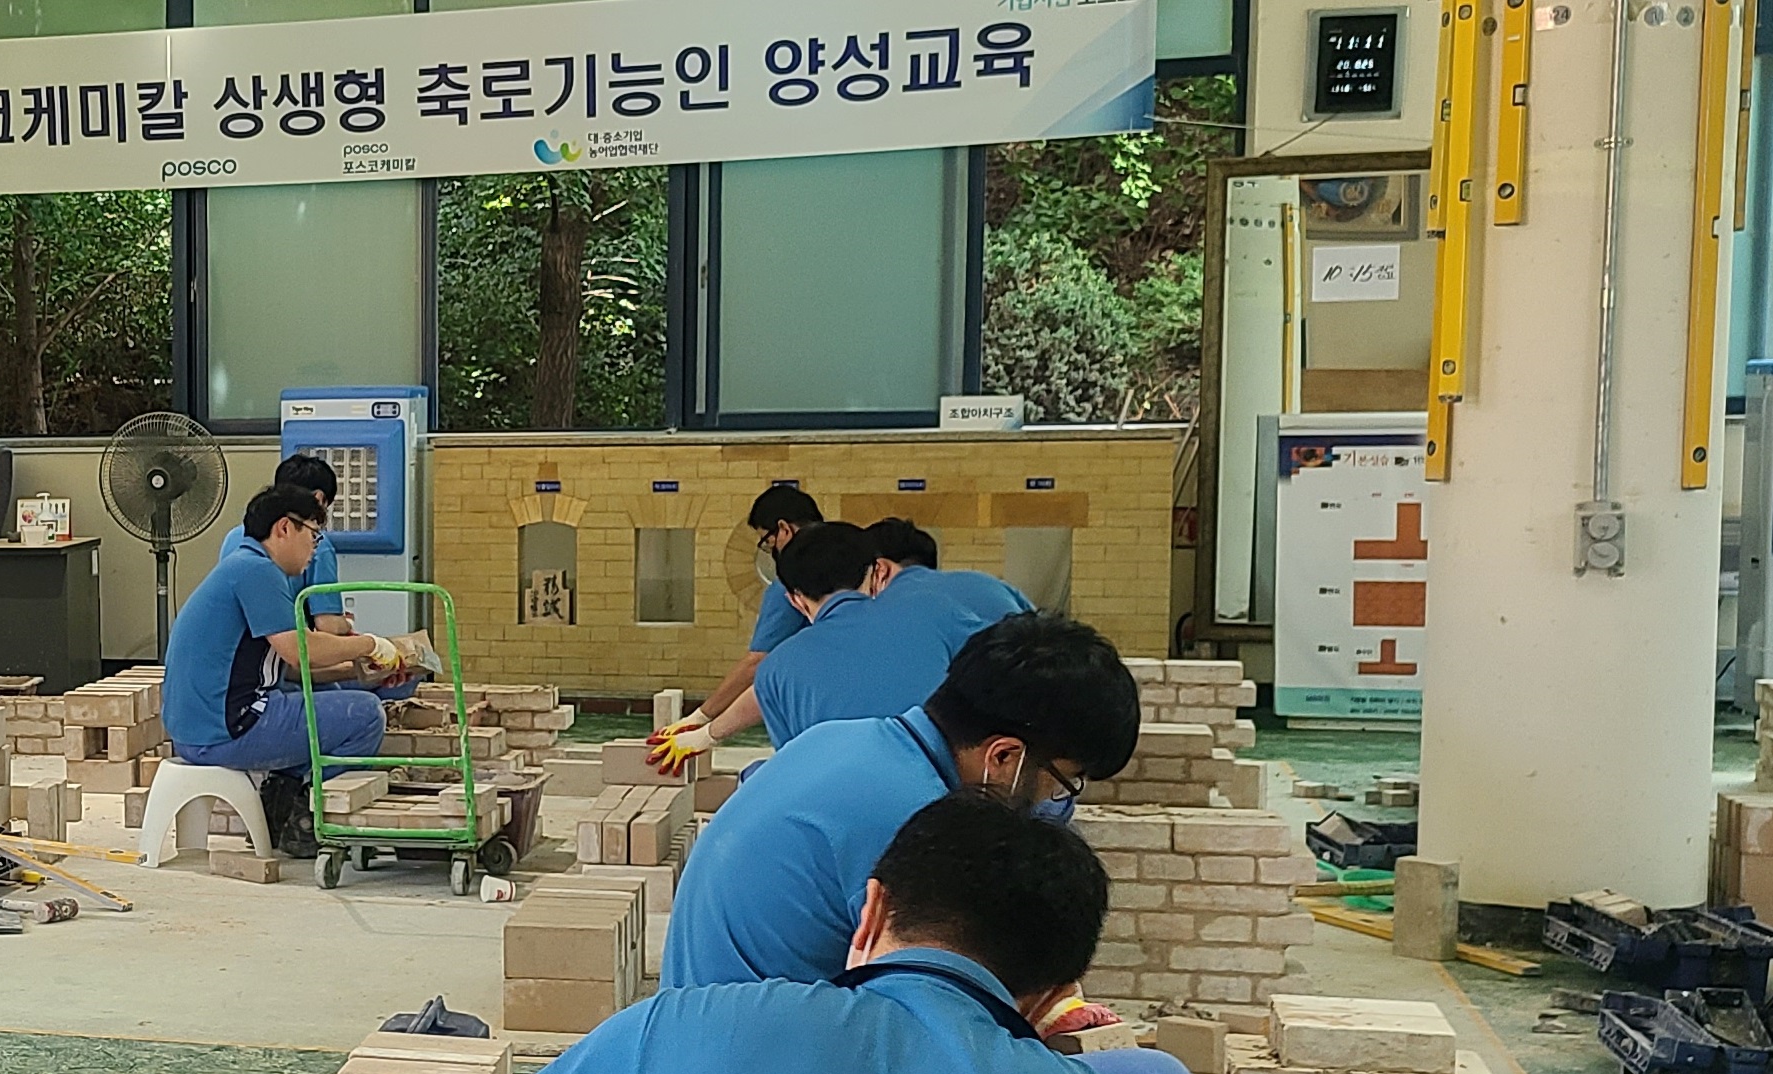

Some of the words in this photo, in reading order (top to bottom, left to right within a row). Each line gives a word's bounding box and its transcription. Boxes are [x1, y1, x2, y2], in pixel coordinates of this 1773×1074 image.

[213, 67, 386, 139] 상생형
[416, 43, 730, 127] 축로기능인
[764, 22, 1035, 107] 양성교육
[343, 143, 389, 158] posco
[588, 143, 659, 158] 농어업협력재단
[161, 158, 238, 182] posco
[342, 158, 416, 174] 포스코케미칼
[948, 407, 1015, 420] 조합아치구조
